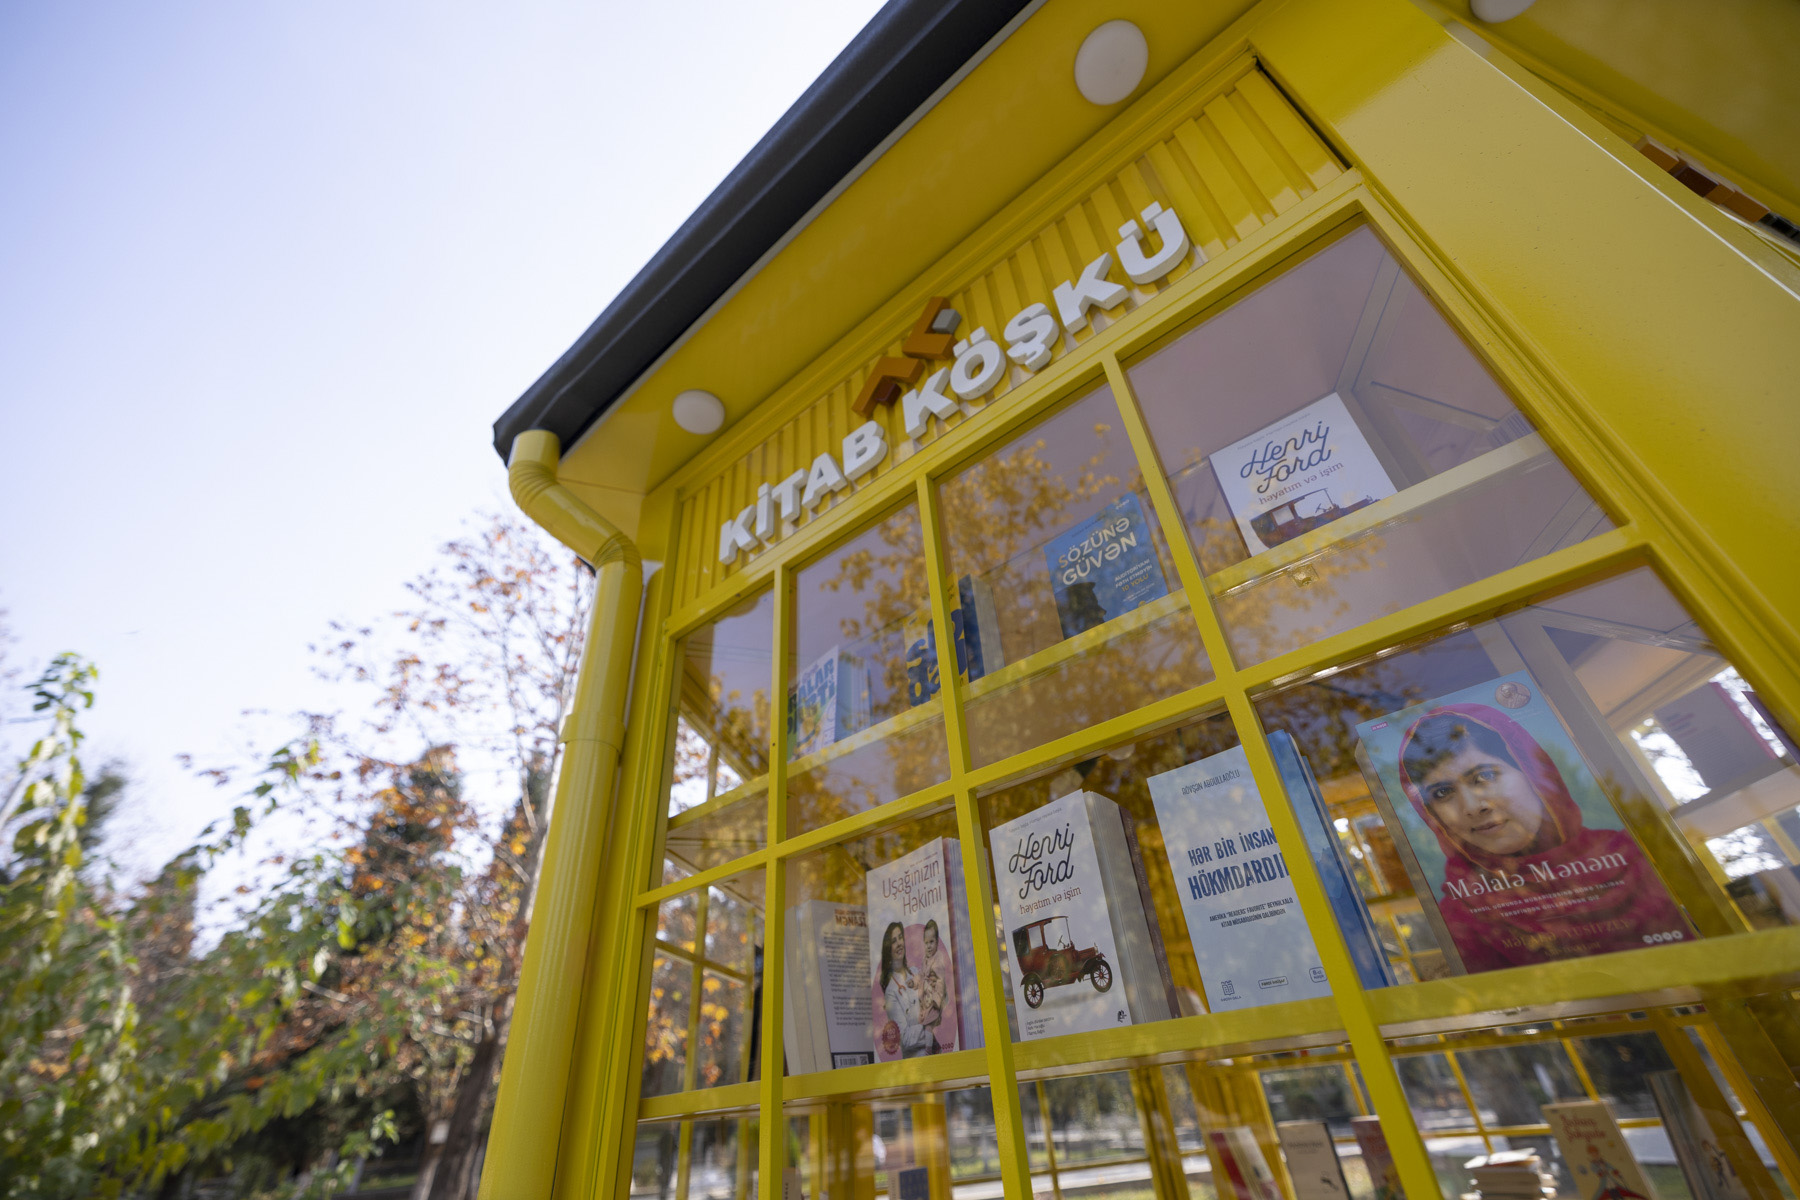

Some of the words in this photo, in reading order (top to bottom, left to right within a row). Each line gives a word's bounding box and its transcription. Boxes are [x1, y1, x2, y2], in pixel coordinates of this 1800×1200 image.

[719, 420, 888, 565] KİTAB
[902, 201, 1190, 440] KÖŞKÜ
[1256, 440, 1332, 494] Ford
[1259, 481, 1303, 505] həyatım
[1303, 474, 1318, 485] və
[1320, 462, 1344, 478] işim
[1058, 517, 1130, 569] SÖZÜNƏ
[1062, 532, 1137, 586] GÜVƏN
[1130, 573, 1149, 587] YOLU
[1188, 845, 1213, 867] HƏR
[1214, 837, 1238, 860] BİR
[1238, 827, 1278, 853] İNSAN
[882, 860, 940, 901] Uşağınızın
[902, 880, 942, 916] Həkimi
[1019, 855, 1075, 900] Ford
[1445, 869, 1526, 900] Məlalə
[1526, 852, 1628, 883] Mənəm
[1020, 896, 1051, 915] həyatım
[1052, 892, 1063, 904] və
[1064, 886, 1082, 901] işim
